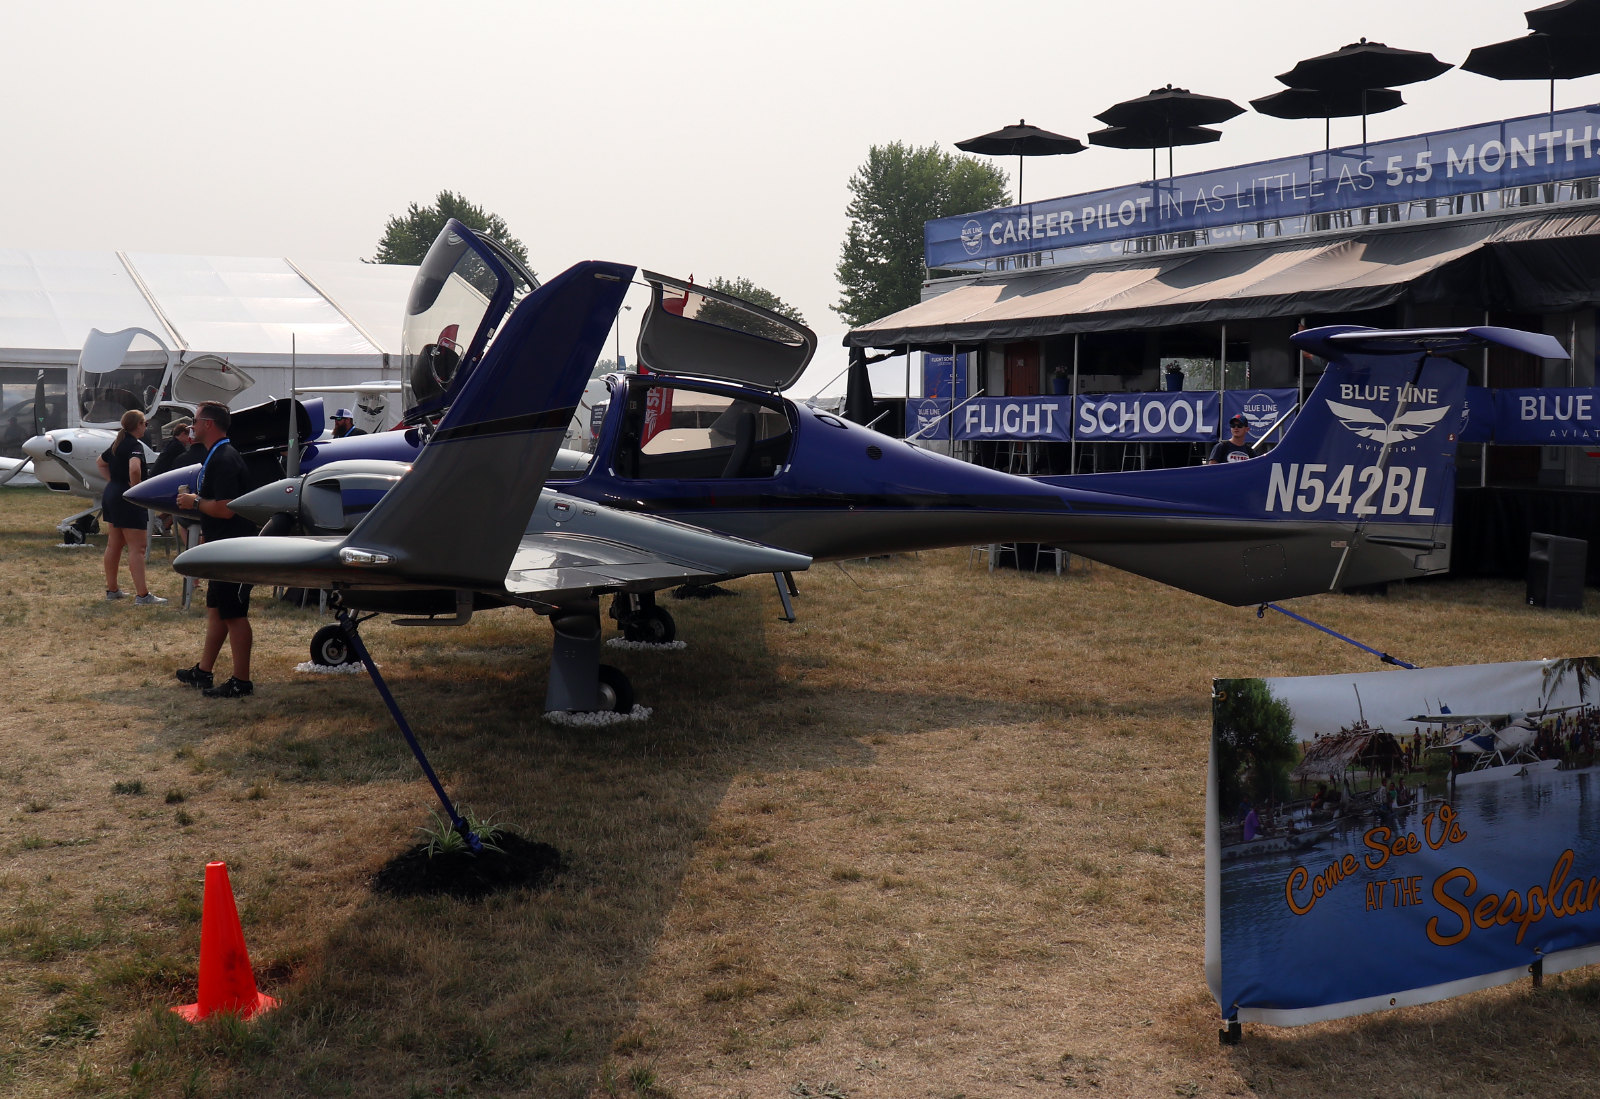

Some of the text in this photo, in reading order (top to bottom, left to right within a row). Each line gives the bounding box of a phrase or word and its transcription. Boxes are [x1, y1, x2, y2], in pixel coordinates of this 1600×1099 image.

[989, 125, 1600, 245] CAREER PILOT IN AS LITTLE AS 5.5 MONTH
[1244, 404, 1278, 412] BLUE LINE
[1339, 384, 1439, 404] BLUE LINE
[1519, 395, 1593, 421] BLUE
[965, 404, 1059, 434] FLIGHT
[1079, 400, 1213, 434] SCHOOL
[1265, 462, 1435, 517] N542BL
[1285, 804, 1468, 916] Come See Us
[1365, 875, 1424, 913] AT THE
